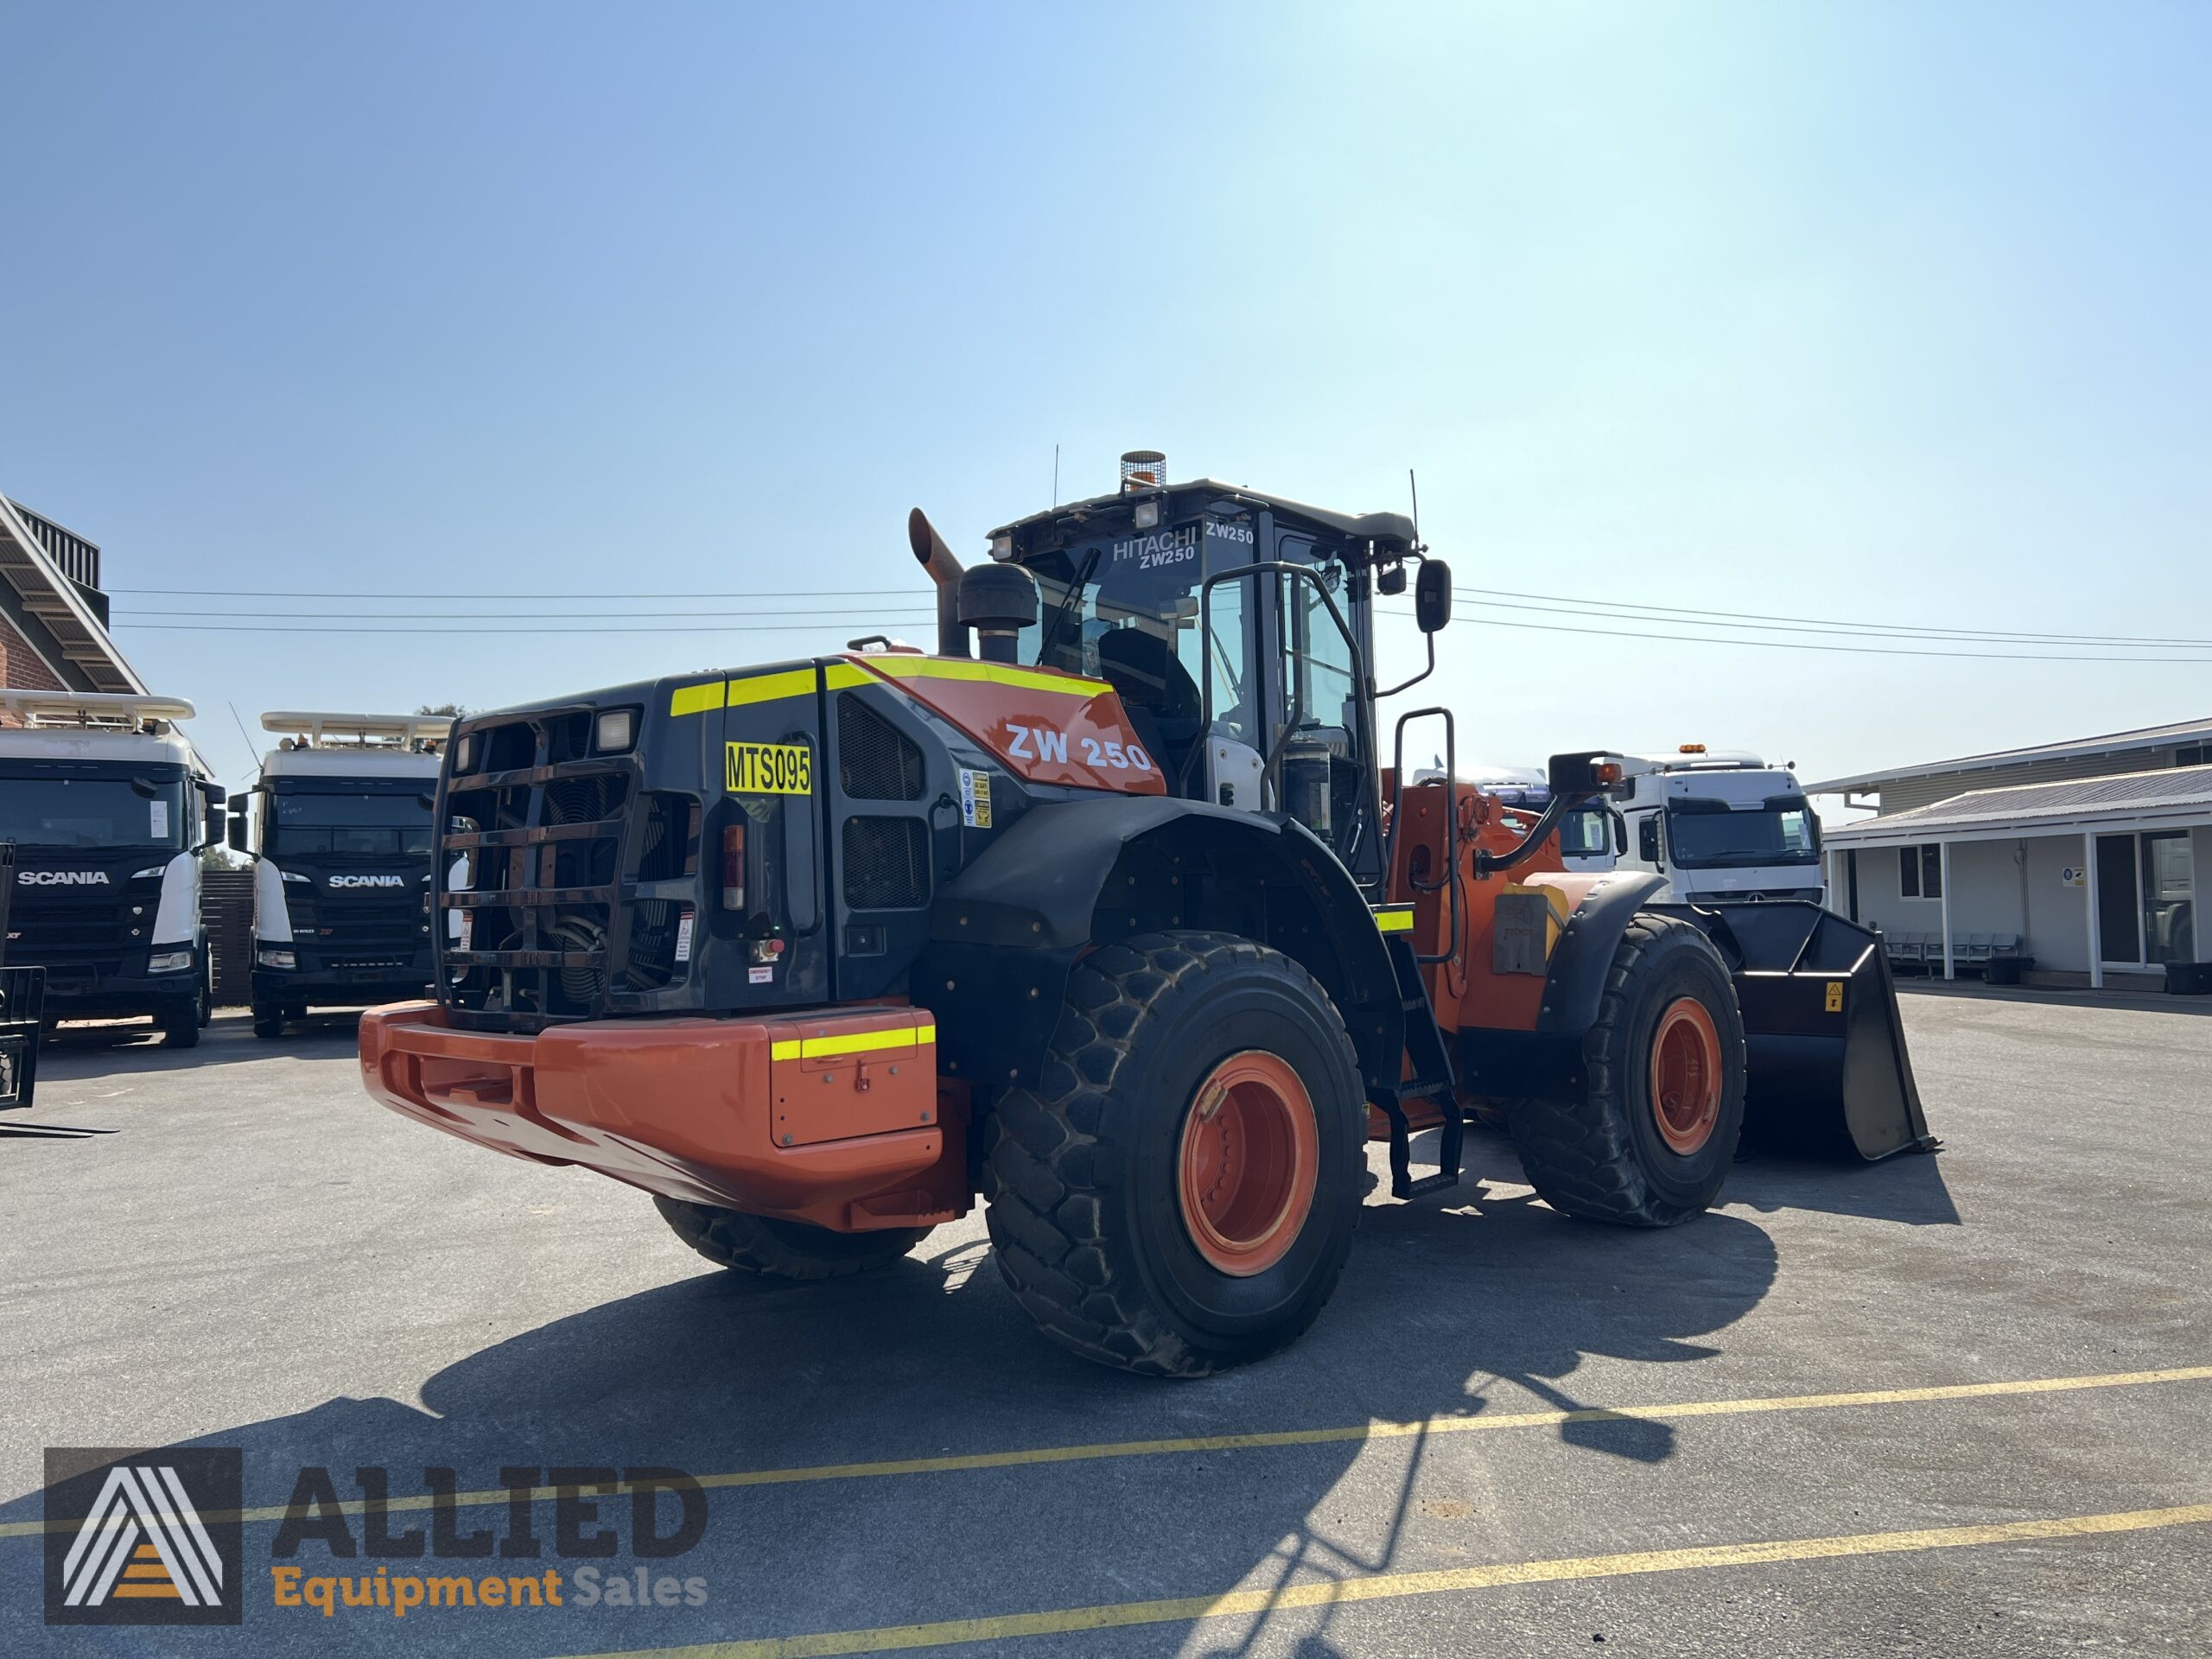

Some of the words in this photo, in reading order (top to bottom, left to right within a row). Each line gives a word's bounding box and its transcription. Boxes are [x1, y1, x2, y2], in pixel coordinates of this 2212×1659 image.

[1113, 526, 1196, 562] HITACHI
[1206, 521, 1254, 545] ZW250
[1140, 546, 1195, 569] ZW250
[1006, 723, 1068, 764] ZW
[1081, 737, 1151, 771] 250
[728, 746, 810, 791] MTS095
[17, 871, 110, 885] SCANIA
[329, 875, 404, 888] SCANIA
